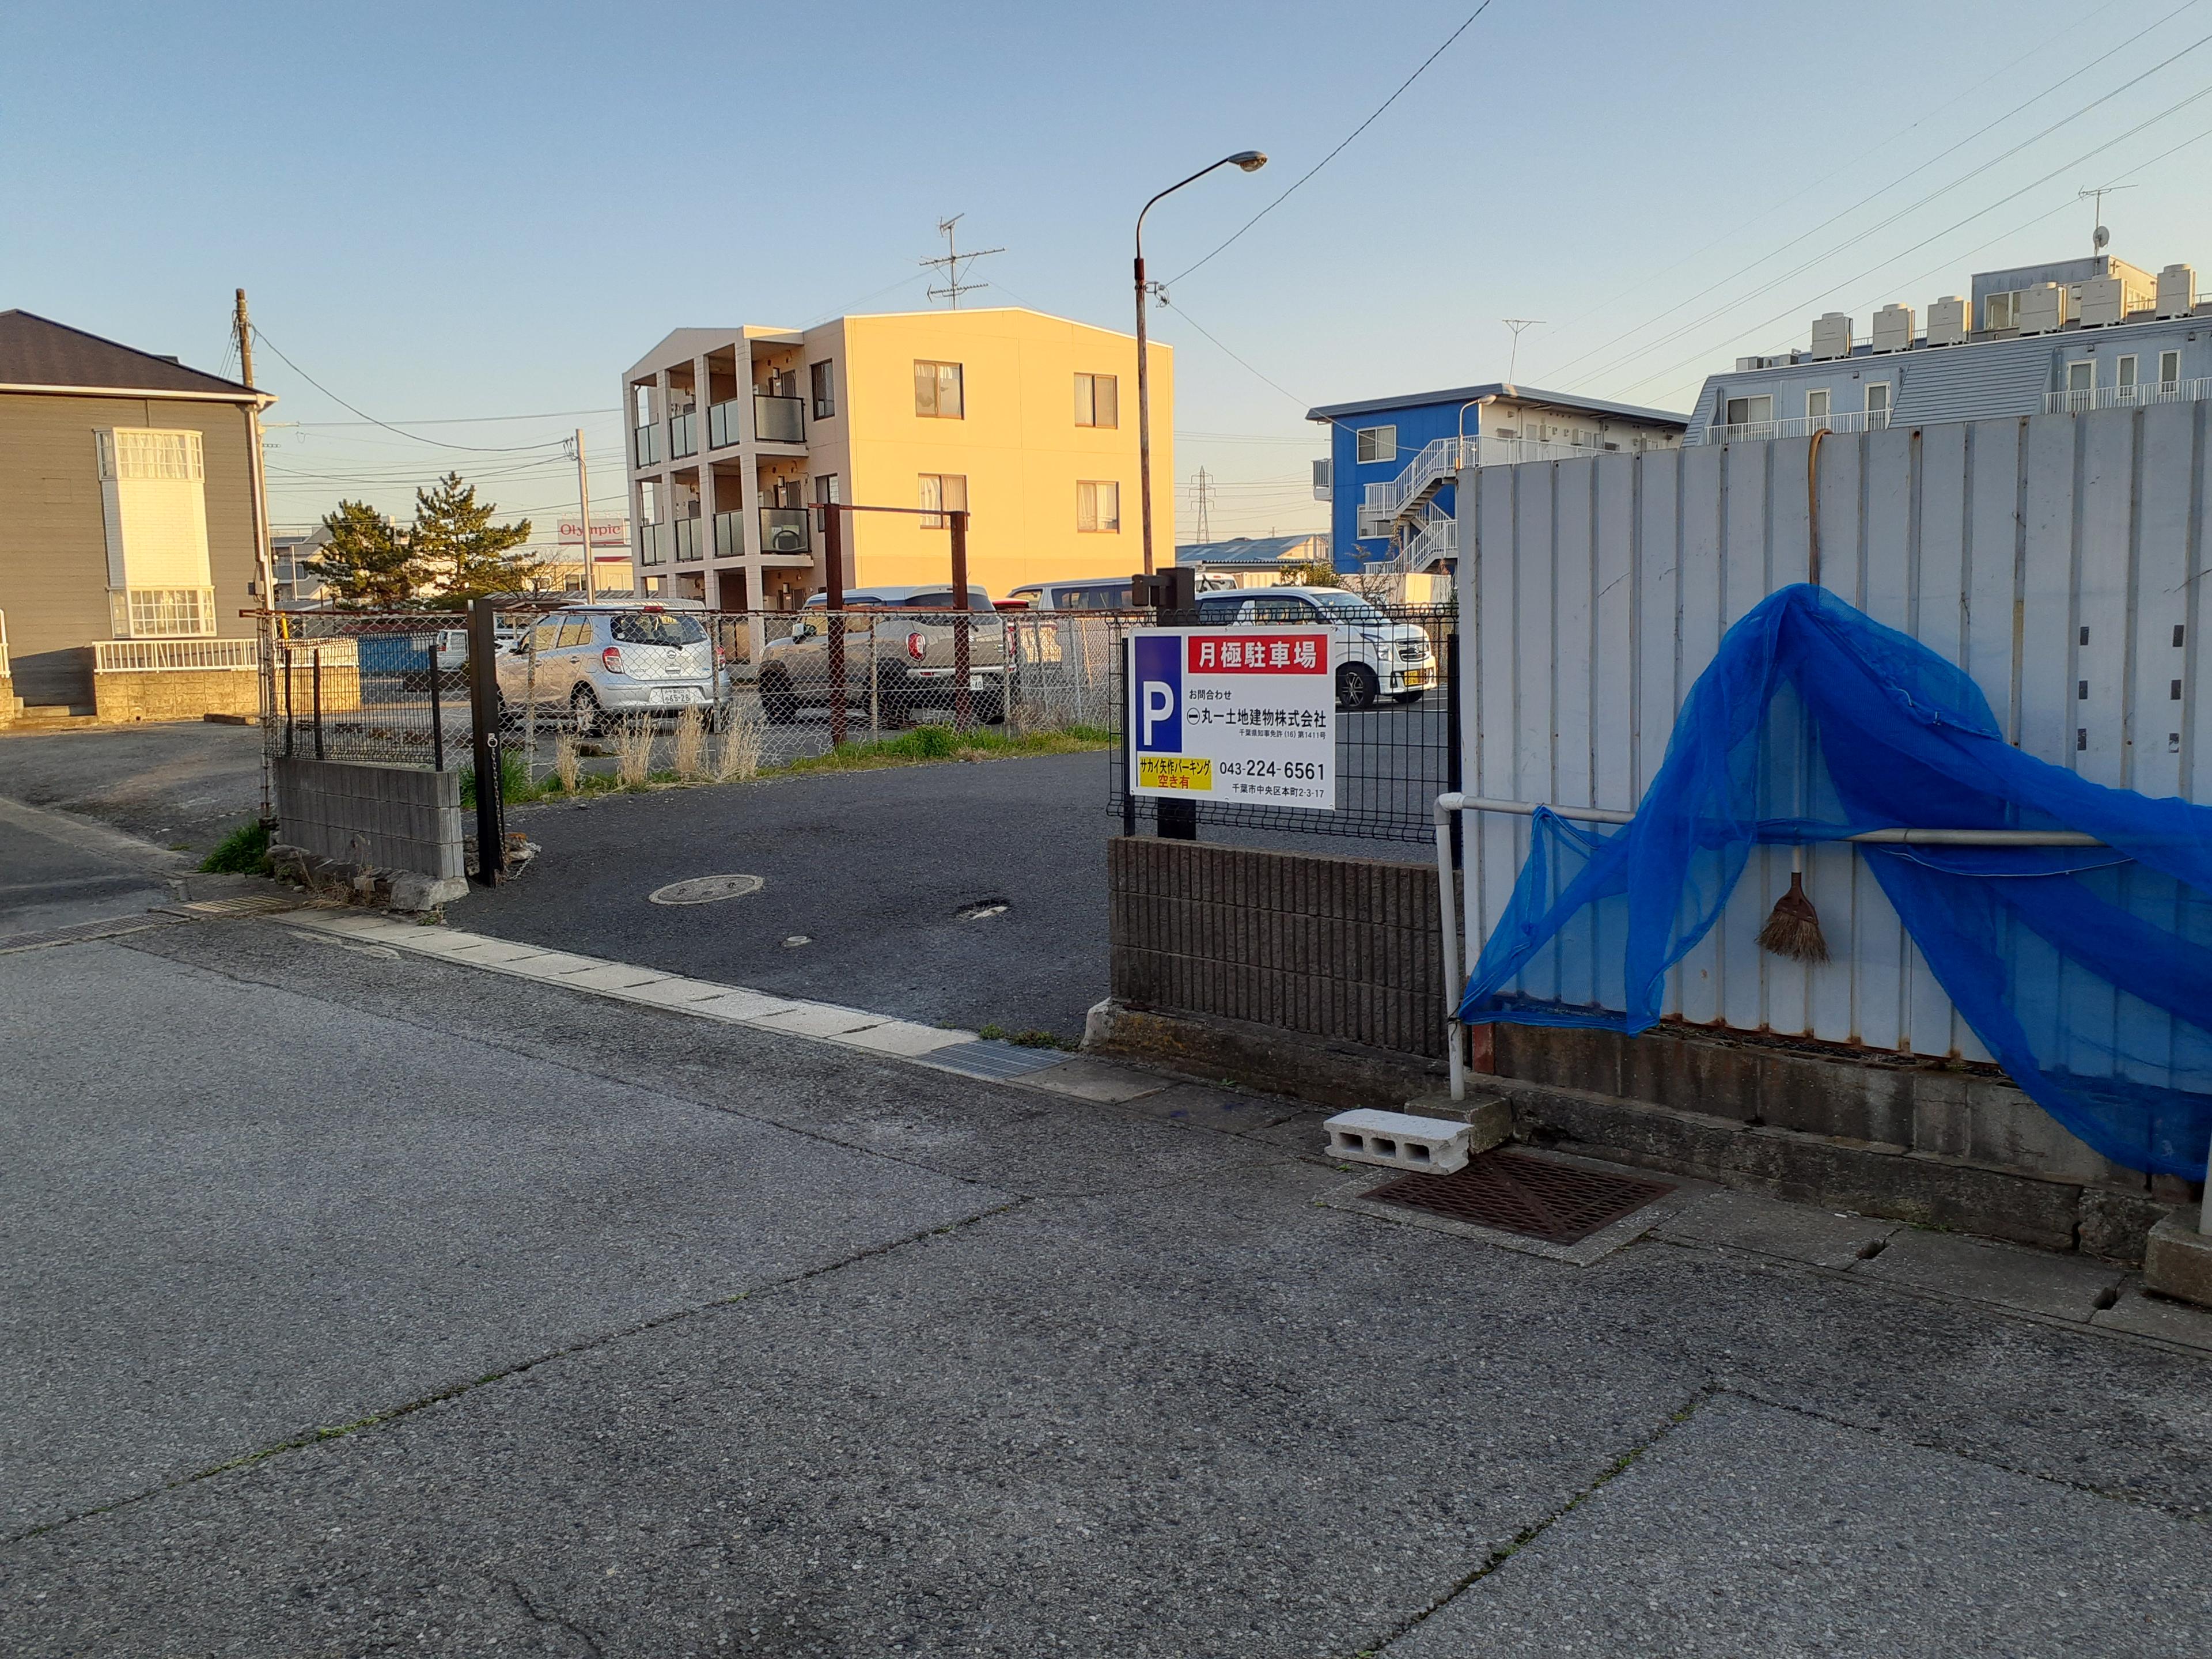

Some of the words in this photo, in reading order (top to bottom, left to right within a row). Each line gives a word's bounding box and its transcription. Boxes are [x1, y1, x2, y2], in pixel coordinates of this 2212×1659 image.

[560, 524, 621, 536] Olympic
[1199, 641, 1317, 669] 月極駐車場
[1189, 689, 1232, 700] お問合わせ
[1143, 681, 1174, 746] P
[1202, 707, 1327, 728] 丸一土地建物株式会社
[1140, 758, 1211, 776] サカイ矢作パーキング
[1219, 759, 1324, 781] 043-224-6561
[1158, 774, 1190, 789] 空き有
[1232, 783, 1324, 798] 千葉市中央区本町2-3-17
